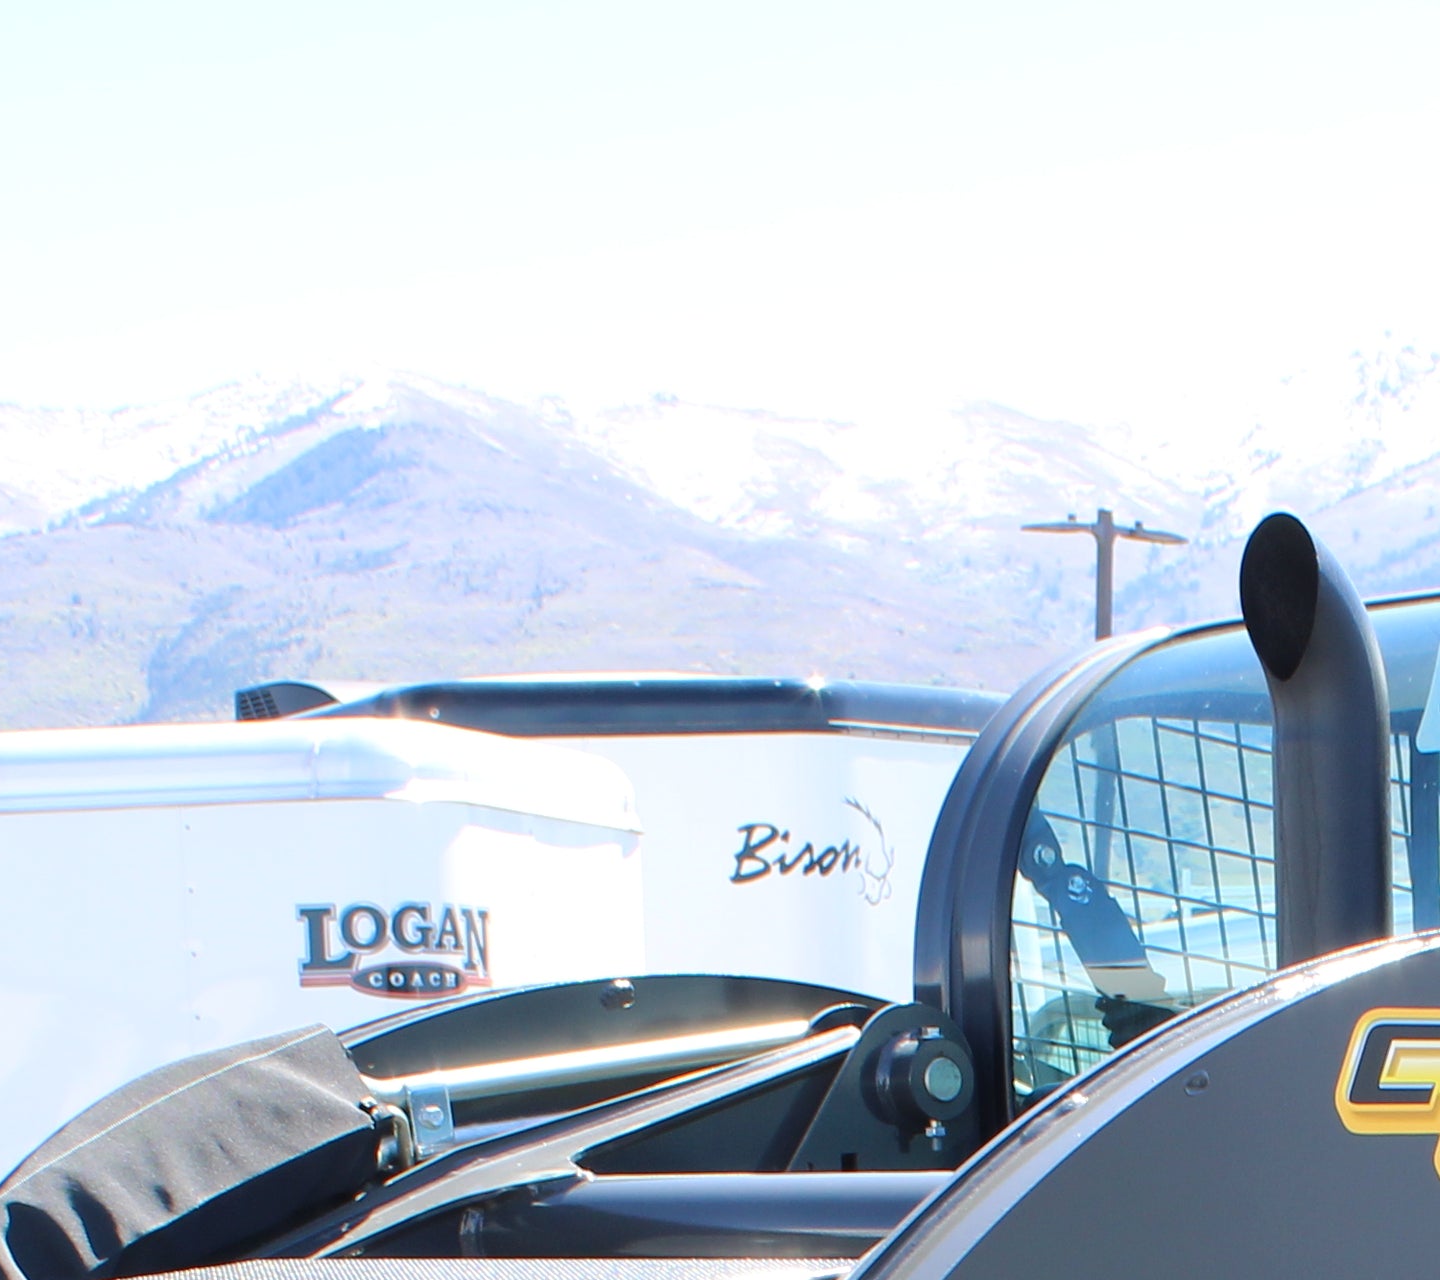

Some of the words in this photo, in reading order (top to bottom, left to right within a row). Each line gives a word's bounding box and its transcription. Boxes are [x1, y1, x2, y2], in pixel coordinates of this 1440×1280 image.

[729, 822, 861, 885] Bison
[297, 903, 490, 977] LOGAN
[368, 969, 458, 988] COACH
